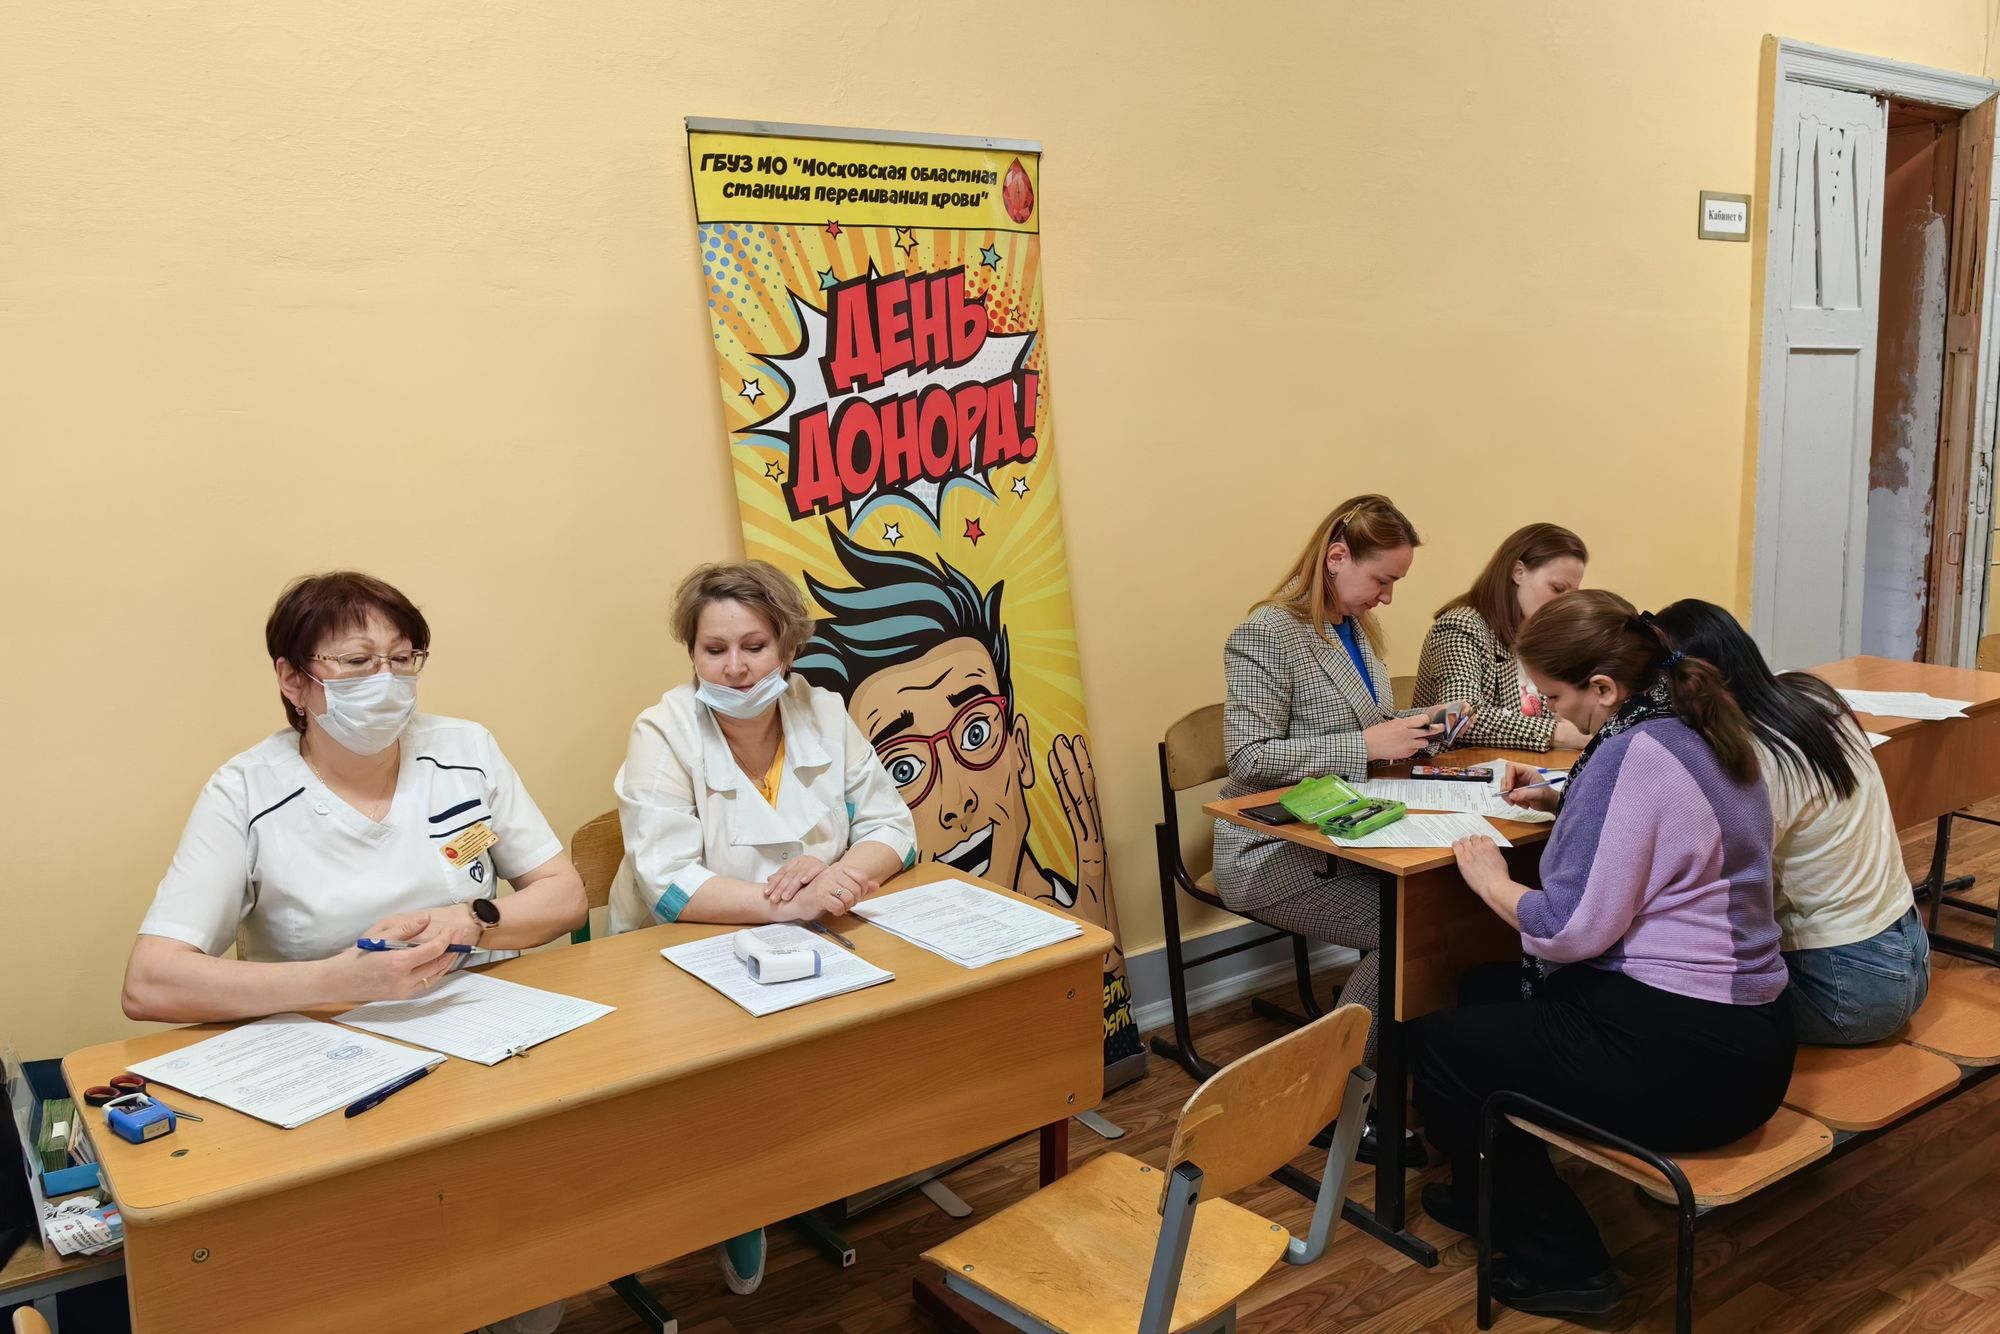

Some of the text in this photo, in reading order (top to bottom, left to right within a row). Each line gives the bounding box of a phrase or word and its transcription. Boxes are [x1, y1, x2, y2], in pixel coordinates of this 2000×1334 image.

[700, 153, 998, 185] ГБУЗ МО "Московская областная
[722, 181, 989, 209] станция переливания крови"
[1708, 209, 1743, 222] Кабинет 6
[826, 268, 989, 394] ДЕНЬ
[789, 371, 1040, 517] ДОНОРА!
